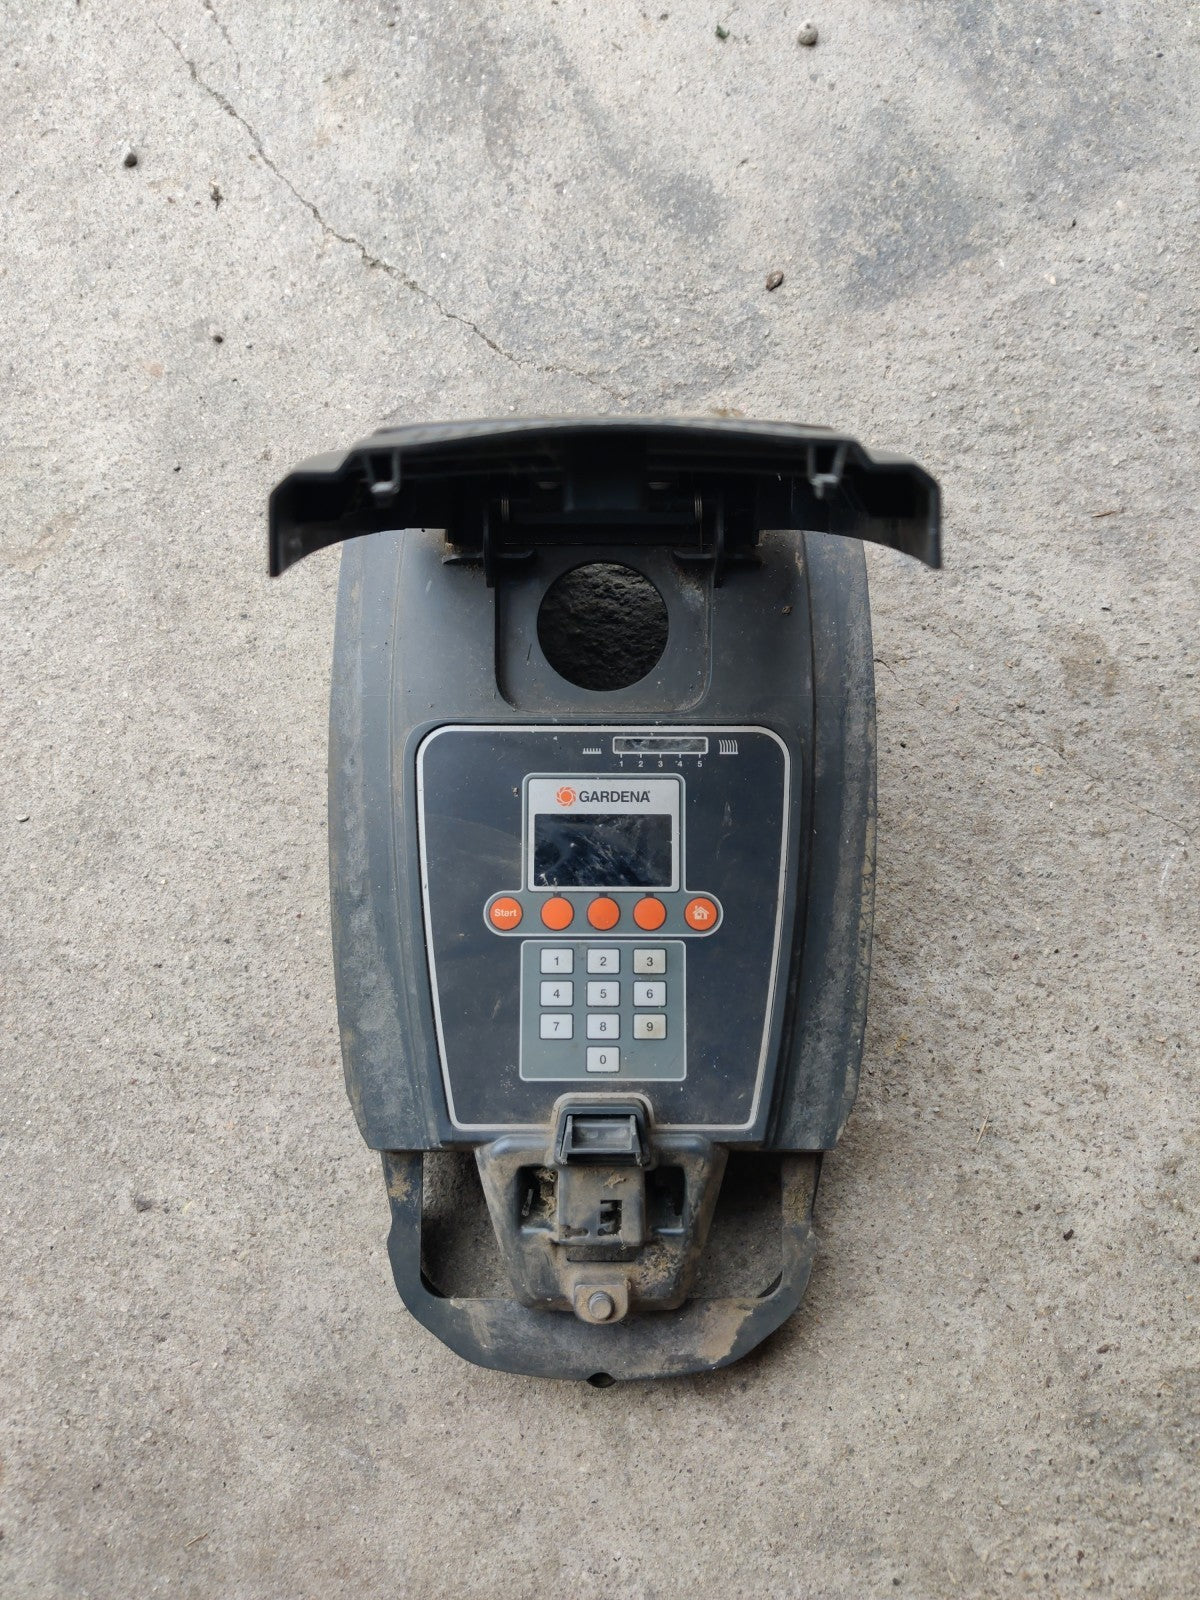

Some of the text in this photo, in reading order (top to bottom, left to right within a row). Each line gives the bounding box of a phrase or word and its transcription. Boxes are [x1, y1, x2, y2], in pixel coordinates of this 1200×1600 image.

[579, 790, 650, 803] GARDENA
[494, 908, 517, 917] Start
[600, 956, 607, 966] 2
[646, 957, 653, 966] 3
[553, 989, 560, 998] 4
[600, 989, 607, 998] 5
[646, 989, 653, 998] 6
[553, 1022, 560, 1031] 7
[600, 1022, 607, 1031] 8
[646, 1022, 653, 1031] 9
[600, 1055, 607, 1064] 0
